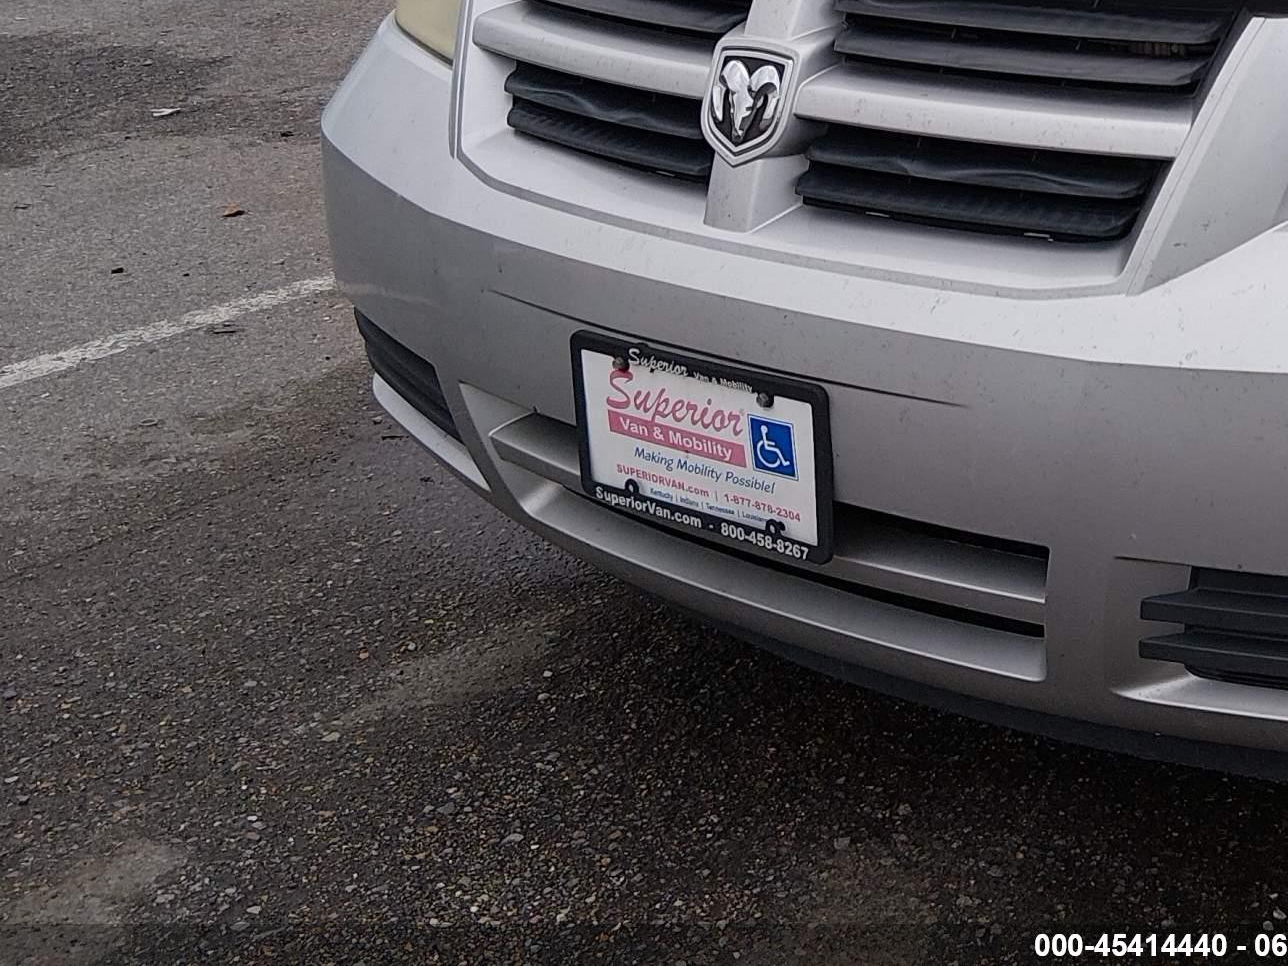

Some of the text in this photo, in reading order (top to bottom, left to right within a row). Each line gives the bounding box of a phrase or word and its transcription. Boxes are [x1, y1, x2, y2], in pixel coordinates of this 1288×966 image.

[627, 347, 689, 377] Superior
[719, 378, 753, 393] Mobility
[606, 368, 744, 437] Superior
[619, 417, 733, 461] Van & Mobility
[616, 463, 710, 499] SUPERIORVAN.com
[634, 446, 776, 495] Making Mobility Possible!
[595, 486, 703, 530] SuperiorVan.com
[720, 521, 809, 561] 800-458-8267
